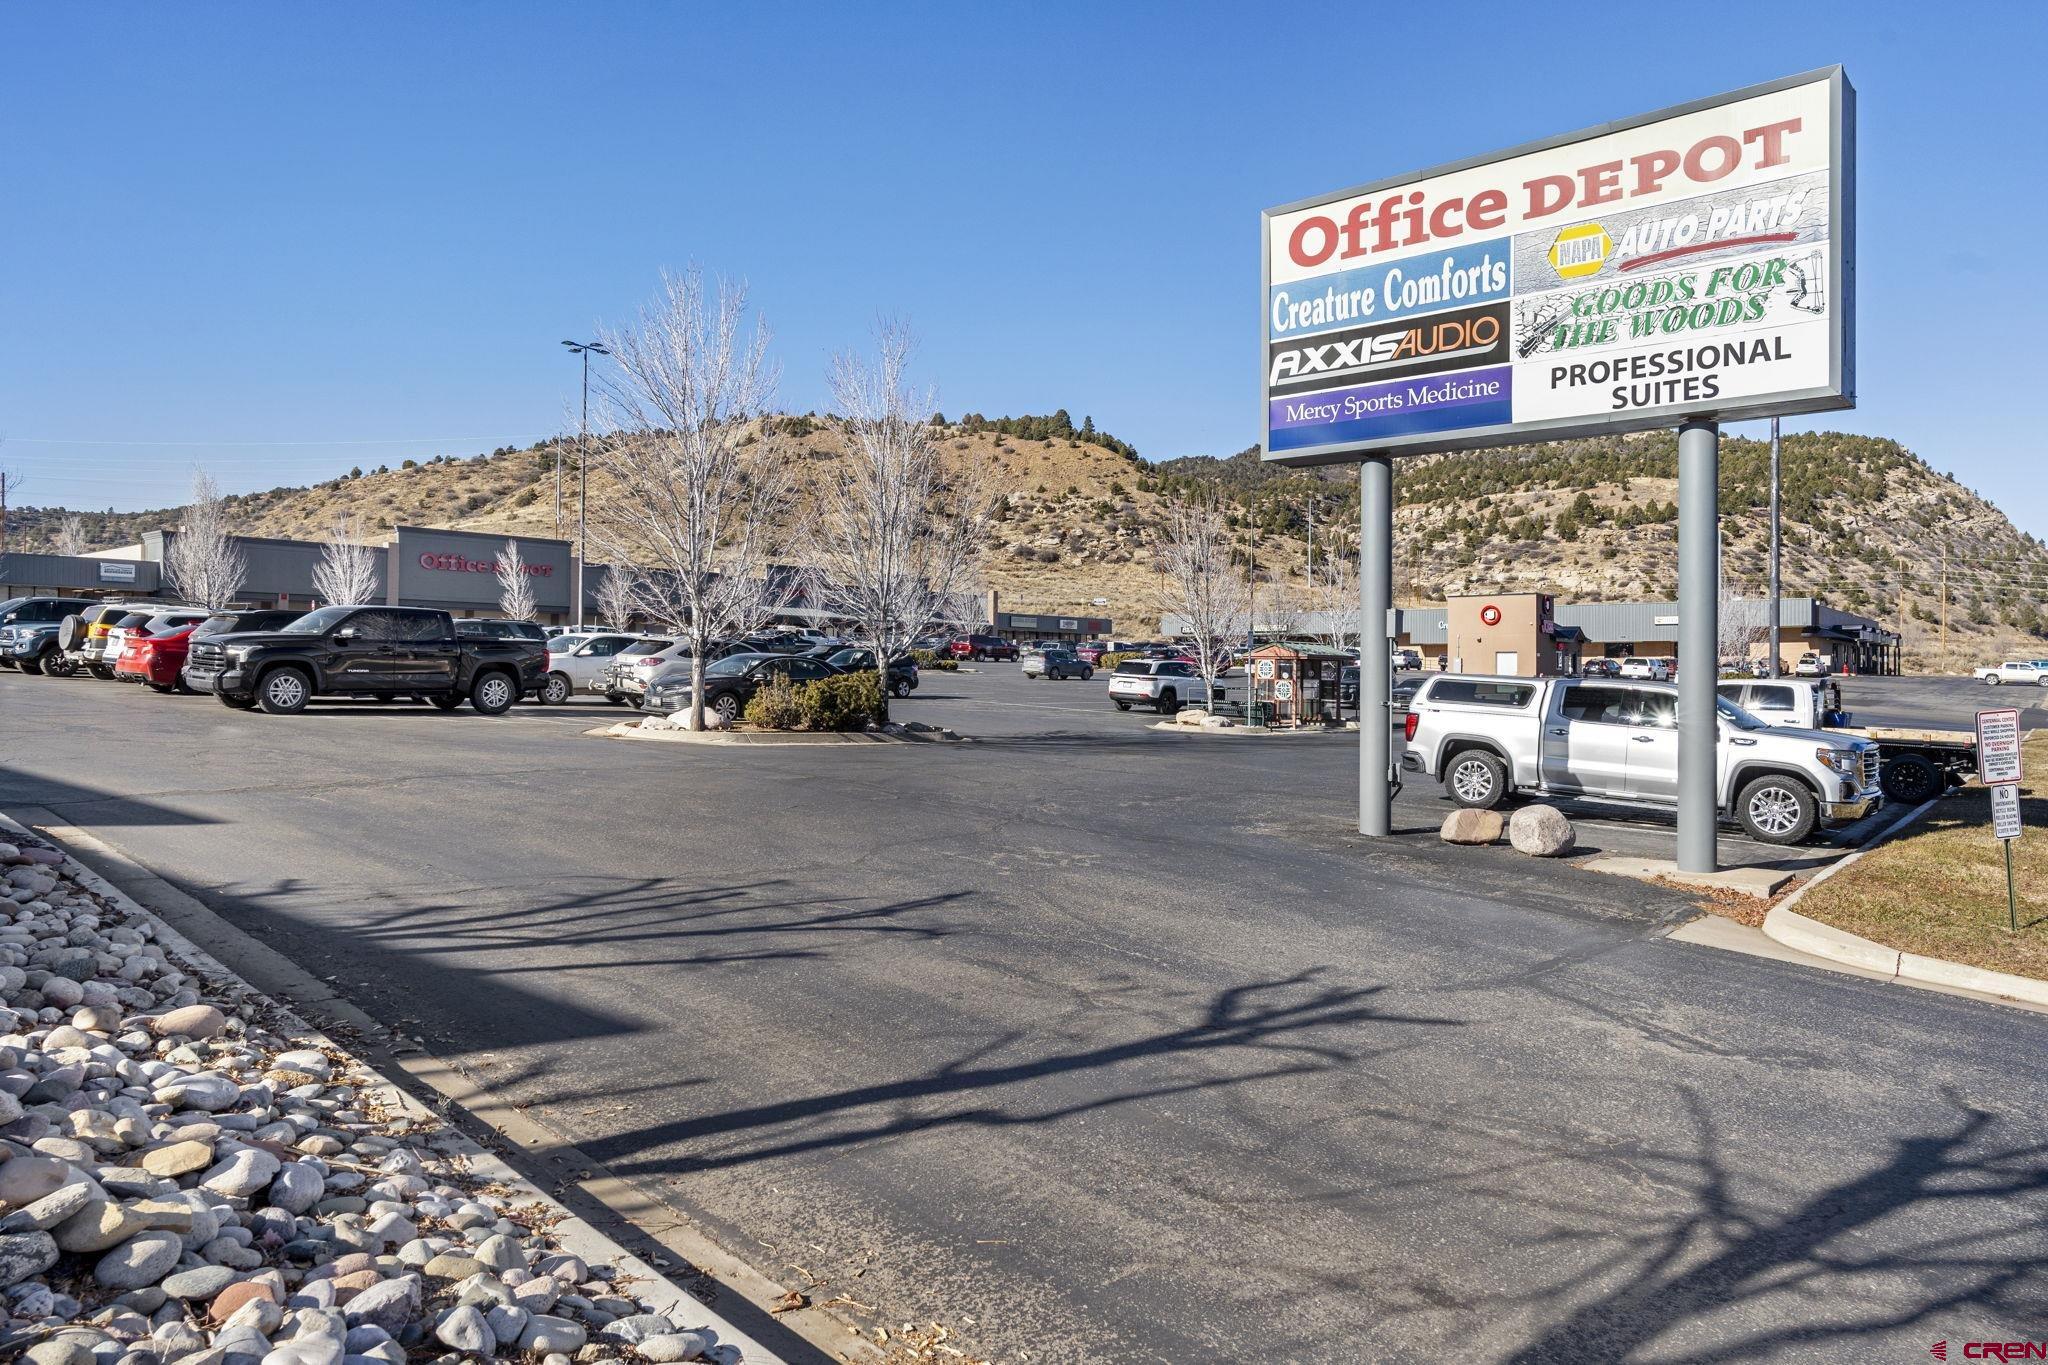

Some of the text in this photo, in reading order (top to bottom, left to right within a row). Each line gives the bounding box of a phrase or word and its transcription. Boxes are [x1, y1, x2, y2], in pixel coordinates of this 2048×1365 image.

[1288, 117, 1802, 267] Office DEPOT
[1615, 187, 1810, 257] AUTO PARTS
[1558, 236, 1603, 267] NAPA
[1272, 254, 1506, 332] Creature Comforts
[1570, 256, 1790, 318] GOODS FOR
[1551, 292, 1770, 350] THE WOODS
[1551, 336, 1792, 389] PROFESSIONAL
[1286, 379, 1500, 423] Mercy Sports Medicine
[1612, 374, 1720, 409] SUITES
[419, 551, 488, 573] Office
[2000, 789, 2008, 799] NO
